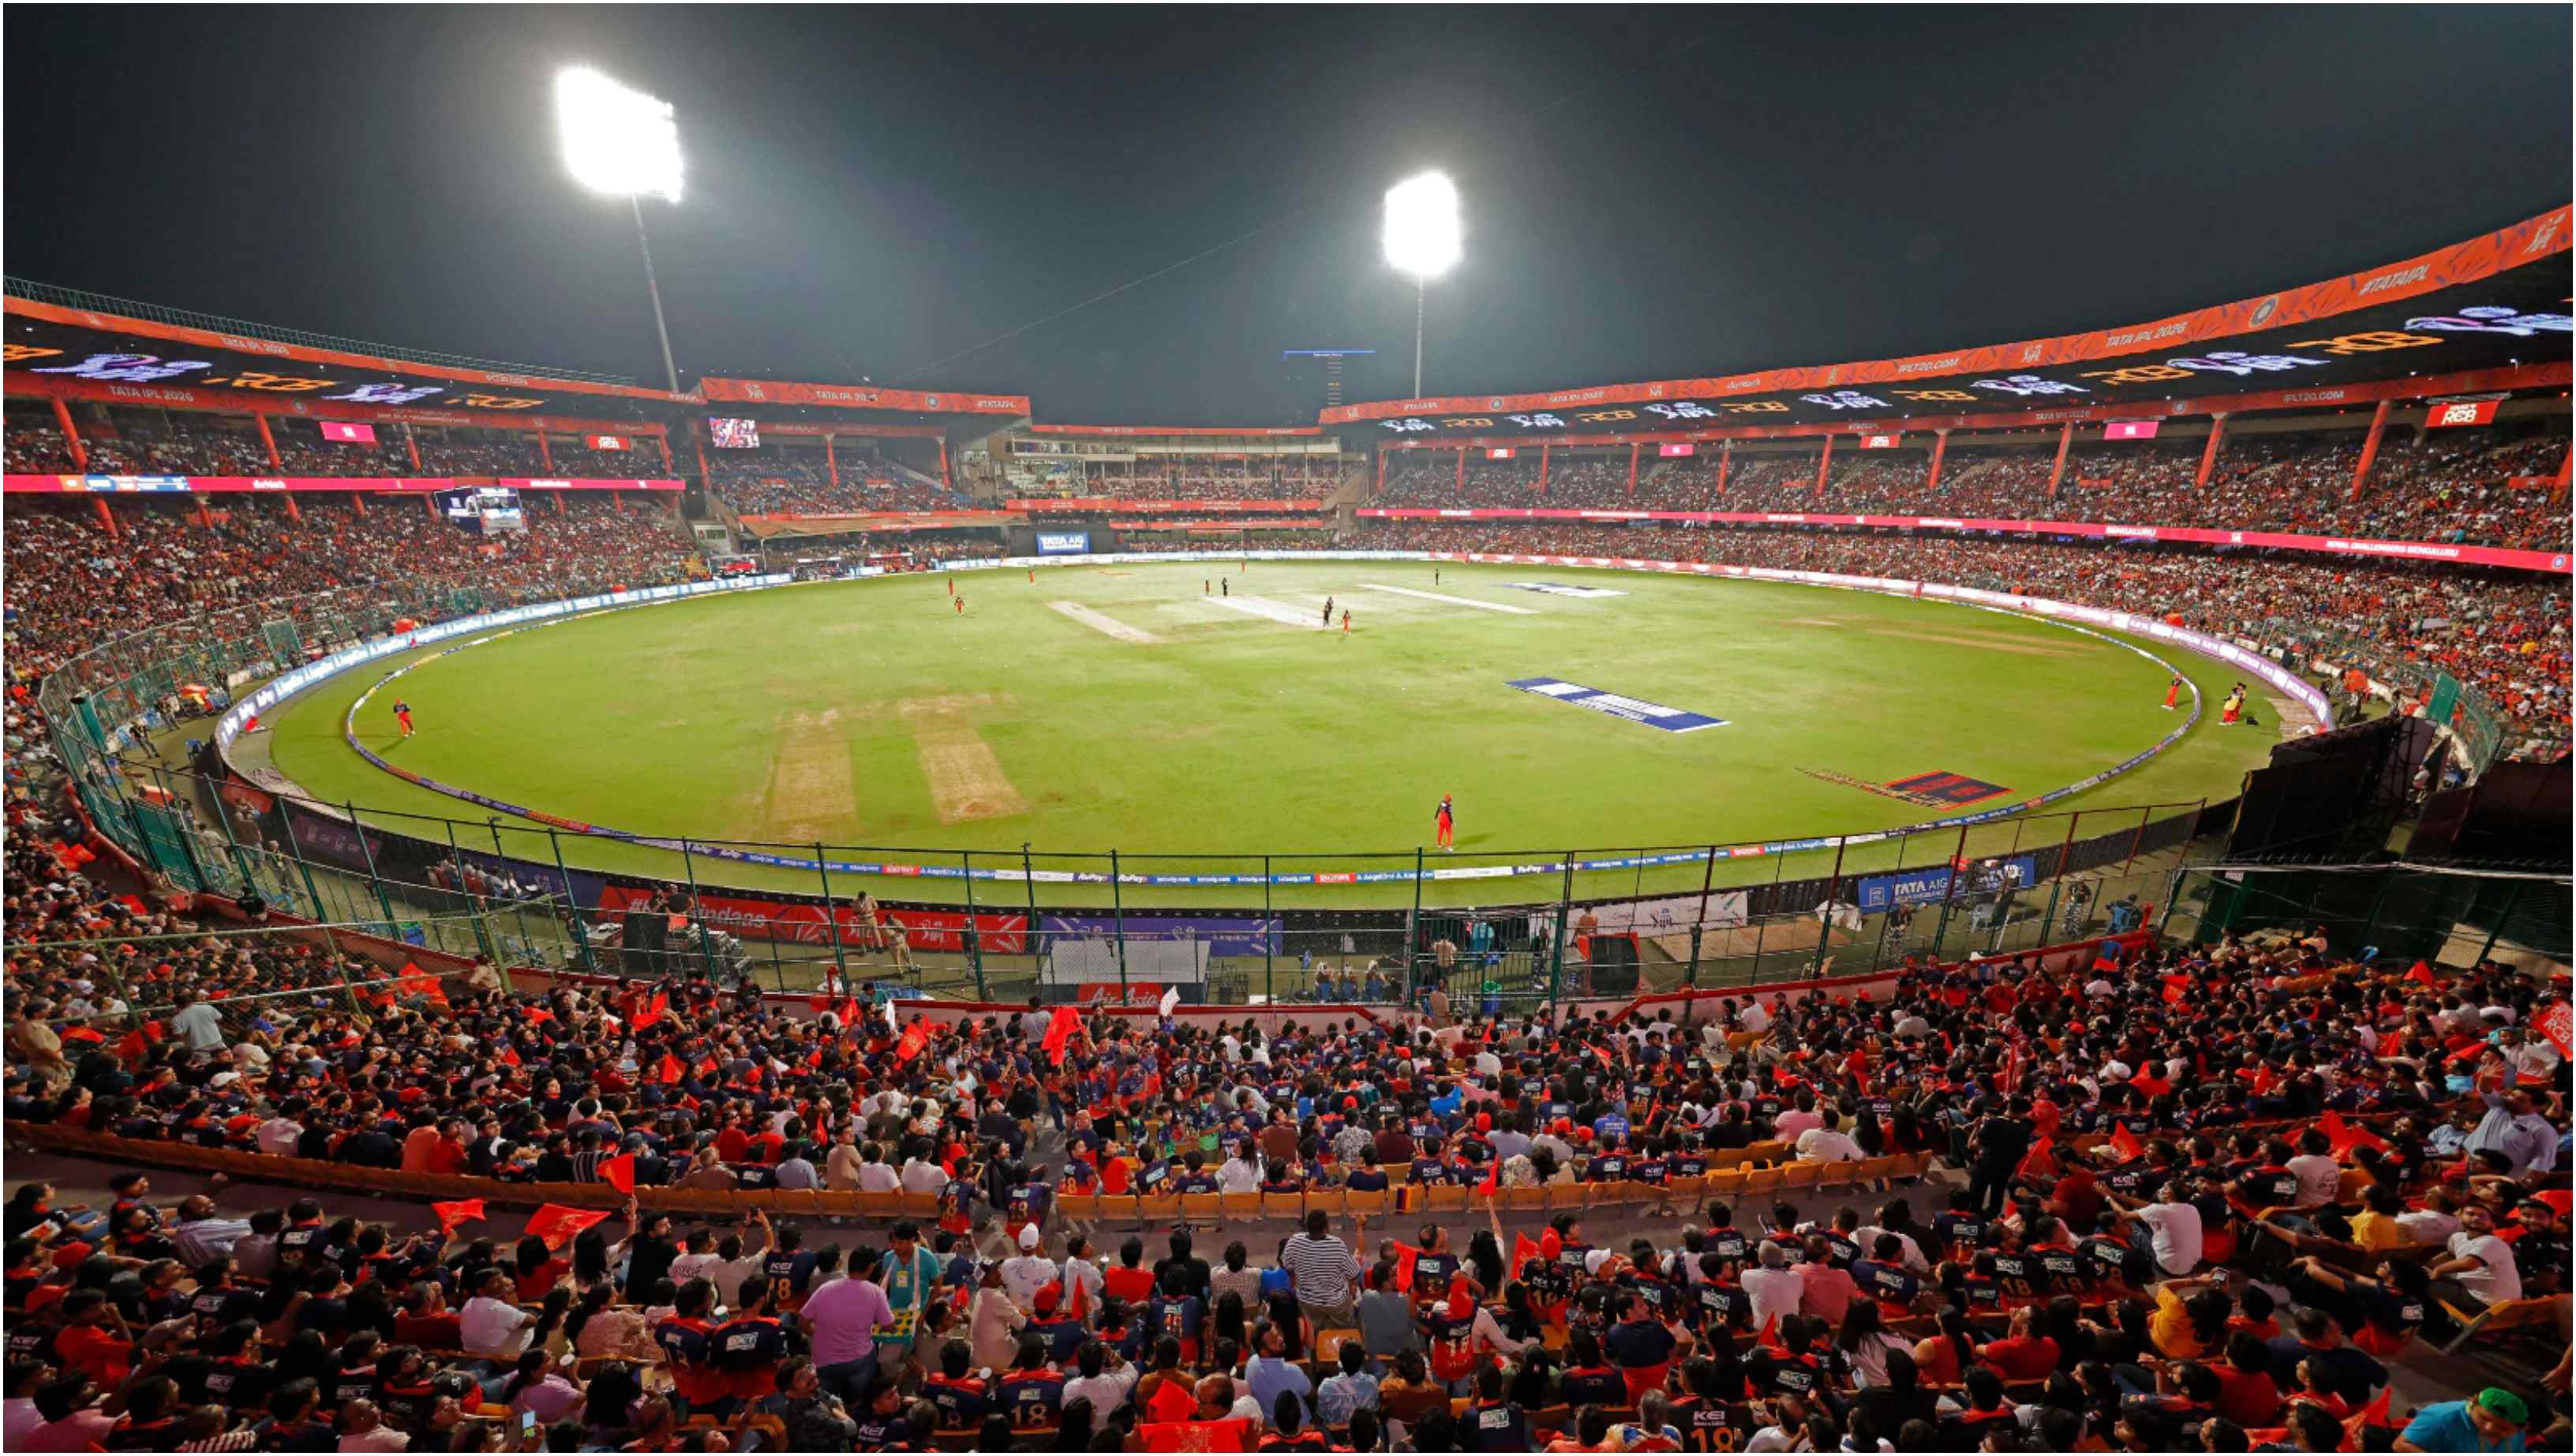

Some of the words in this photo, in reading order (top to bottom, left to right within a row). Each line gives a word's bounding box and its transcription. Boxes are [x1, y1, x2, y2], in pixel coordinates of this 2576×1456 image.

[2359, 264, 2432, 297] #TATAIPL
[2105, 333, 2132, 347] TATA
[2133, 330, 2152, 344] IPL
[2153, 322, 2188, 339] 2026
[1898, 357, 1960, 374] IPLT20.COM
[108, 385, 140, 398] TATA
[141, 388, 161, 399] IPL
[163, 391, 194, 402] 2026
[2283, 389, 2344, 403] IPLT20.COM
[2441, 410, 2477, 425] RCB
[1040, 537, 1067, 546] TATA
[1069, 536, 1084, 545] AIG
[2407, 546, 2459, 558] BENGALURU
[1893, 880, 1926, 896] TATA
[1929, 877, 1948, 890] AIG
[2543, 1017, 2571, 1044] RCB
[769, 1261, 793, 1271] KEI
[11, 1335, 42, 1346] KEI
[1010, 1402, 1048, 1428] 18
[1693, 1409, 1726, 1421] KEI
[859, 1424, 887, 1436] KEI
[1691, 1428, 1735, 1454] 18
